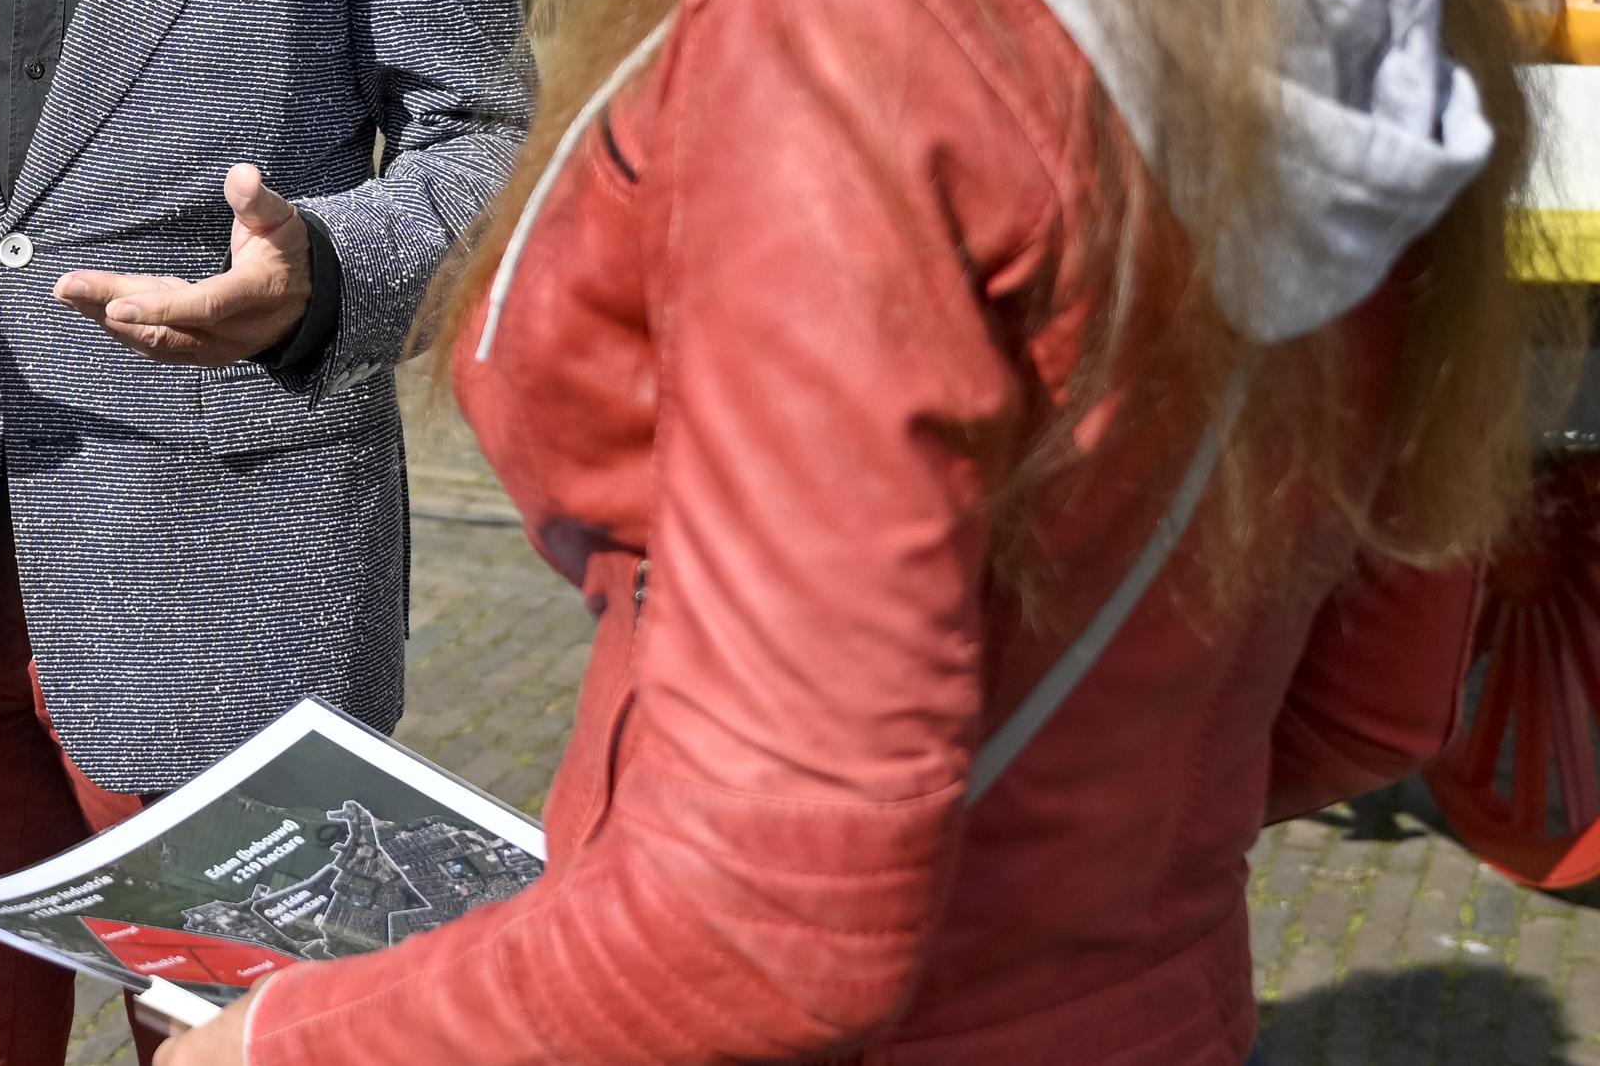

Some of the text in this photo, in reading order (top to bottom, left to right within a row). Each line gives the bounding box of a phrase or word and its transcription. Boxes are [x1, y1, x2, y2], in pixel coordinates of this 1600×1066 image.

[204, 819, 300, 880] Edam (bebouwd)
[256, 835, 305, 866] hectare
[51, 894, 104, 914] hectare
[264, 890, 312, 918] Oud Edam
[289, 895, 328, 916] hectare
